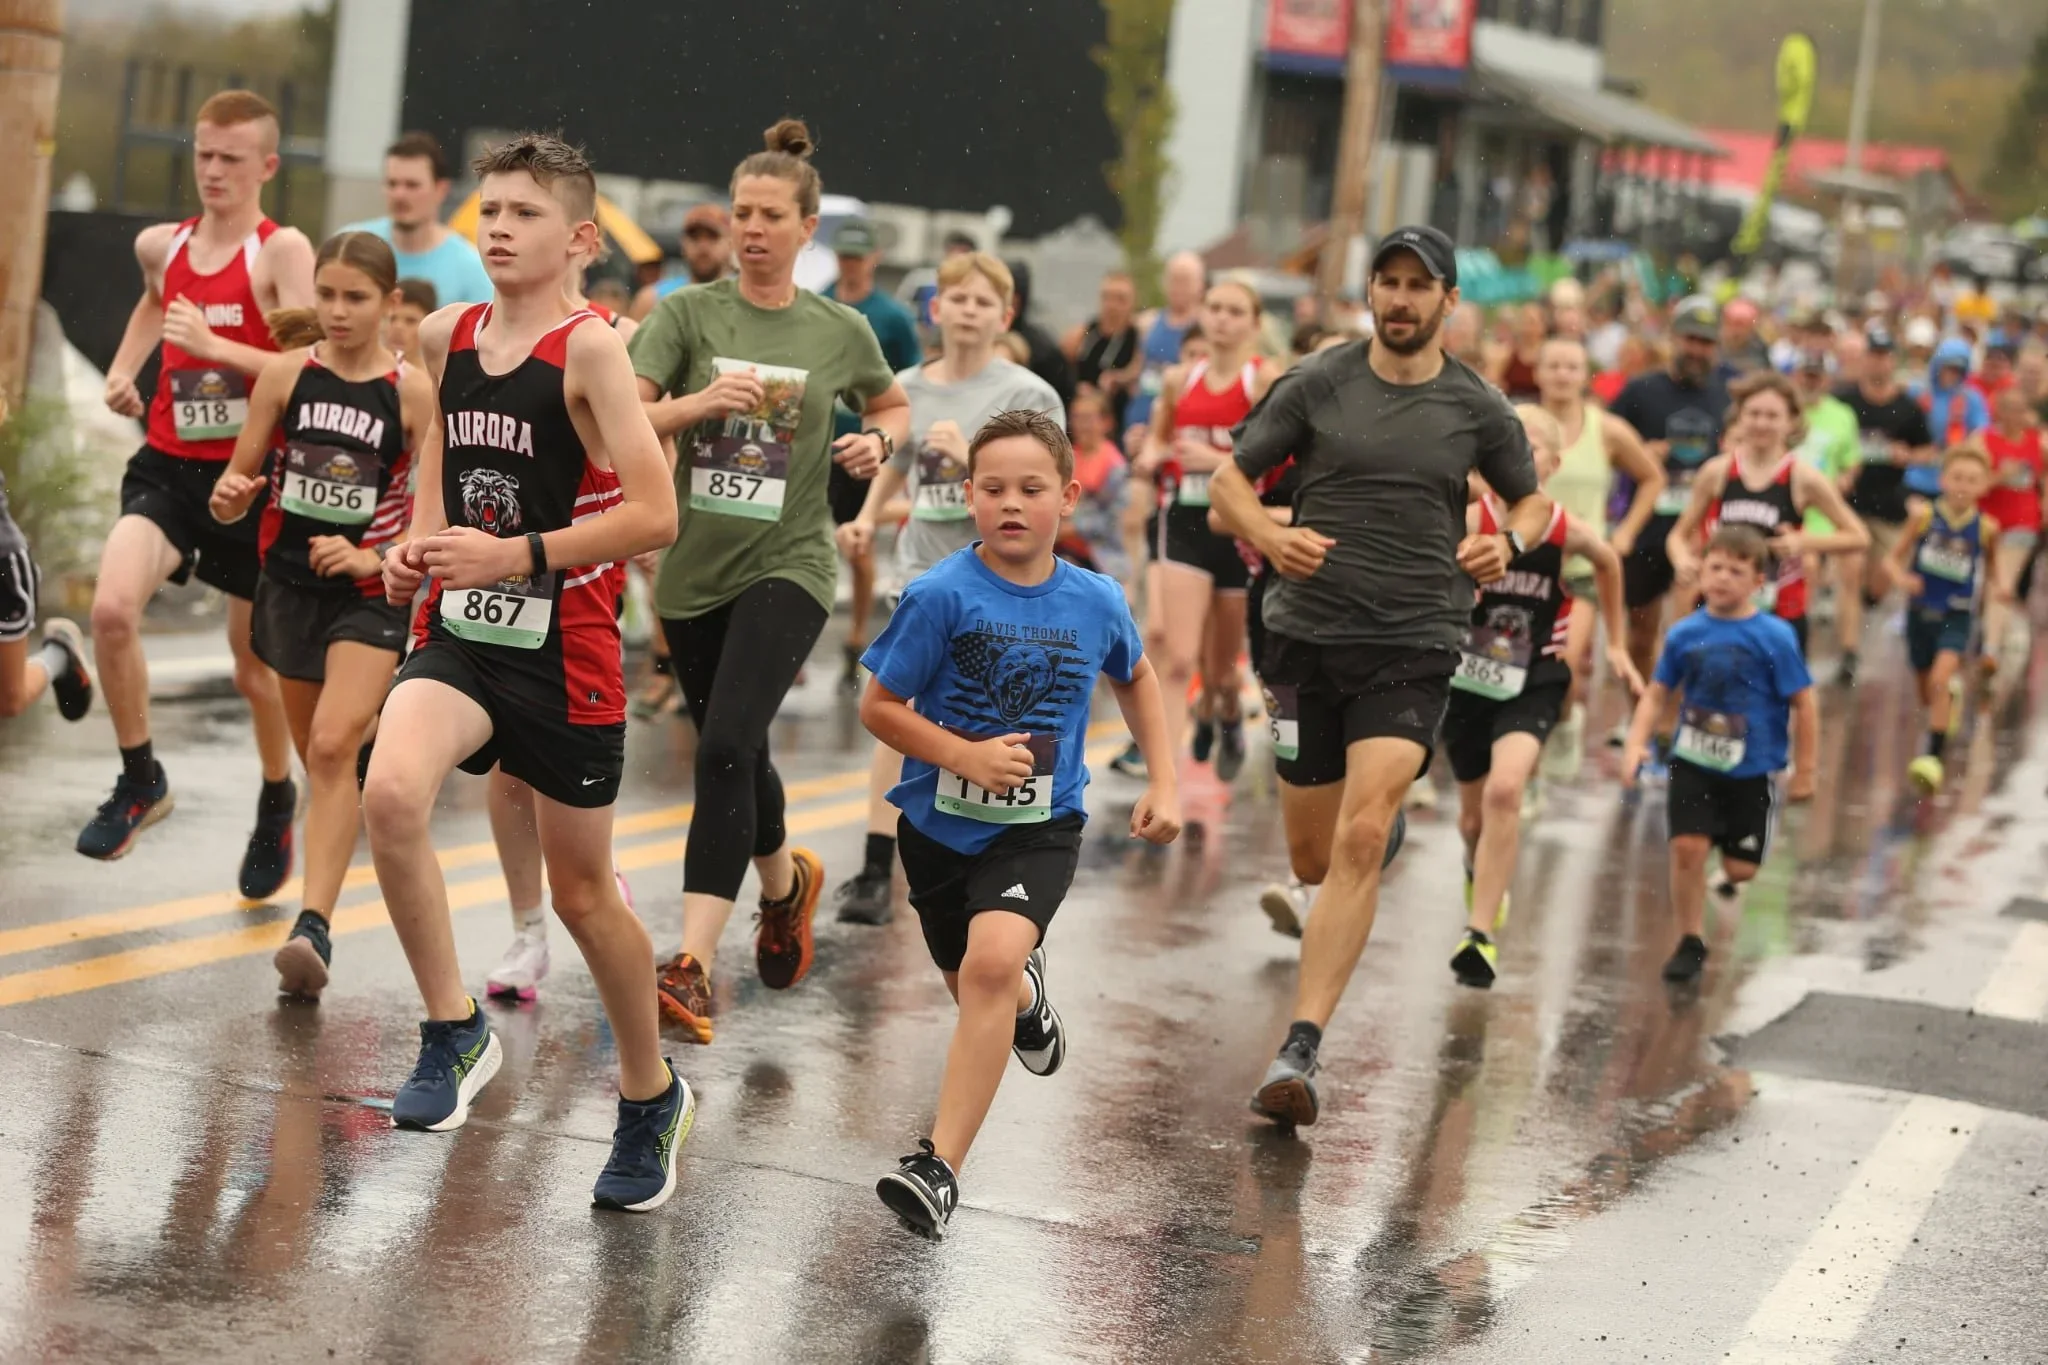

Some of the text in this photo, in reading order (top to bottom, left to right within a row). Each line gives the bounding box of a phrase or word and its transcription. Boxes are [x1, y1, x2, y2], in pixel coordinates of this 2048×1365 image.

[182, 403, 229, 426] 918
[297, 401, 385, 450] AURORA
[446, 410, 534, 458] AURORA
[297, 479, 364, 510] 1056
[709, 473, 763, 500] 857
[463, 590, 527, 628] 867
[977, 620, 1077, 642] DAVIS THOMAS
[1463, 656, 1506, 686] 865
